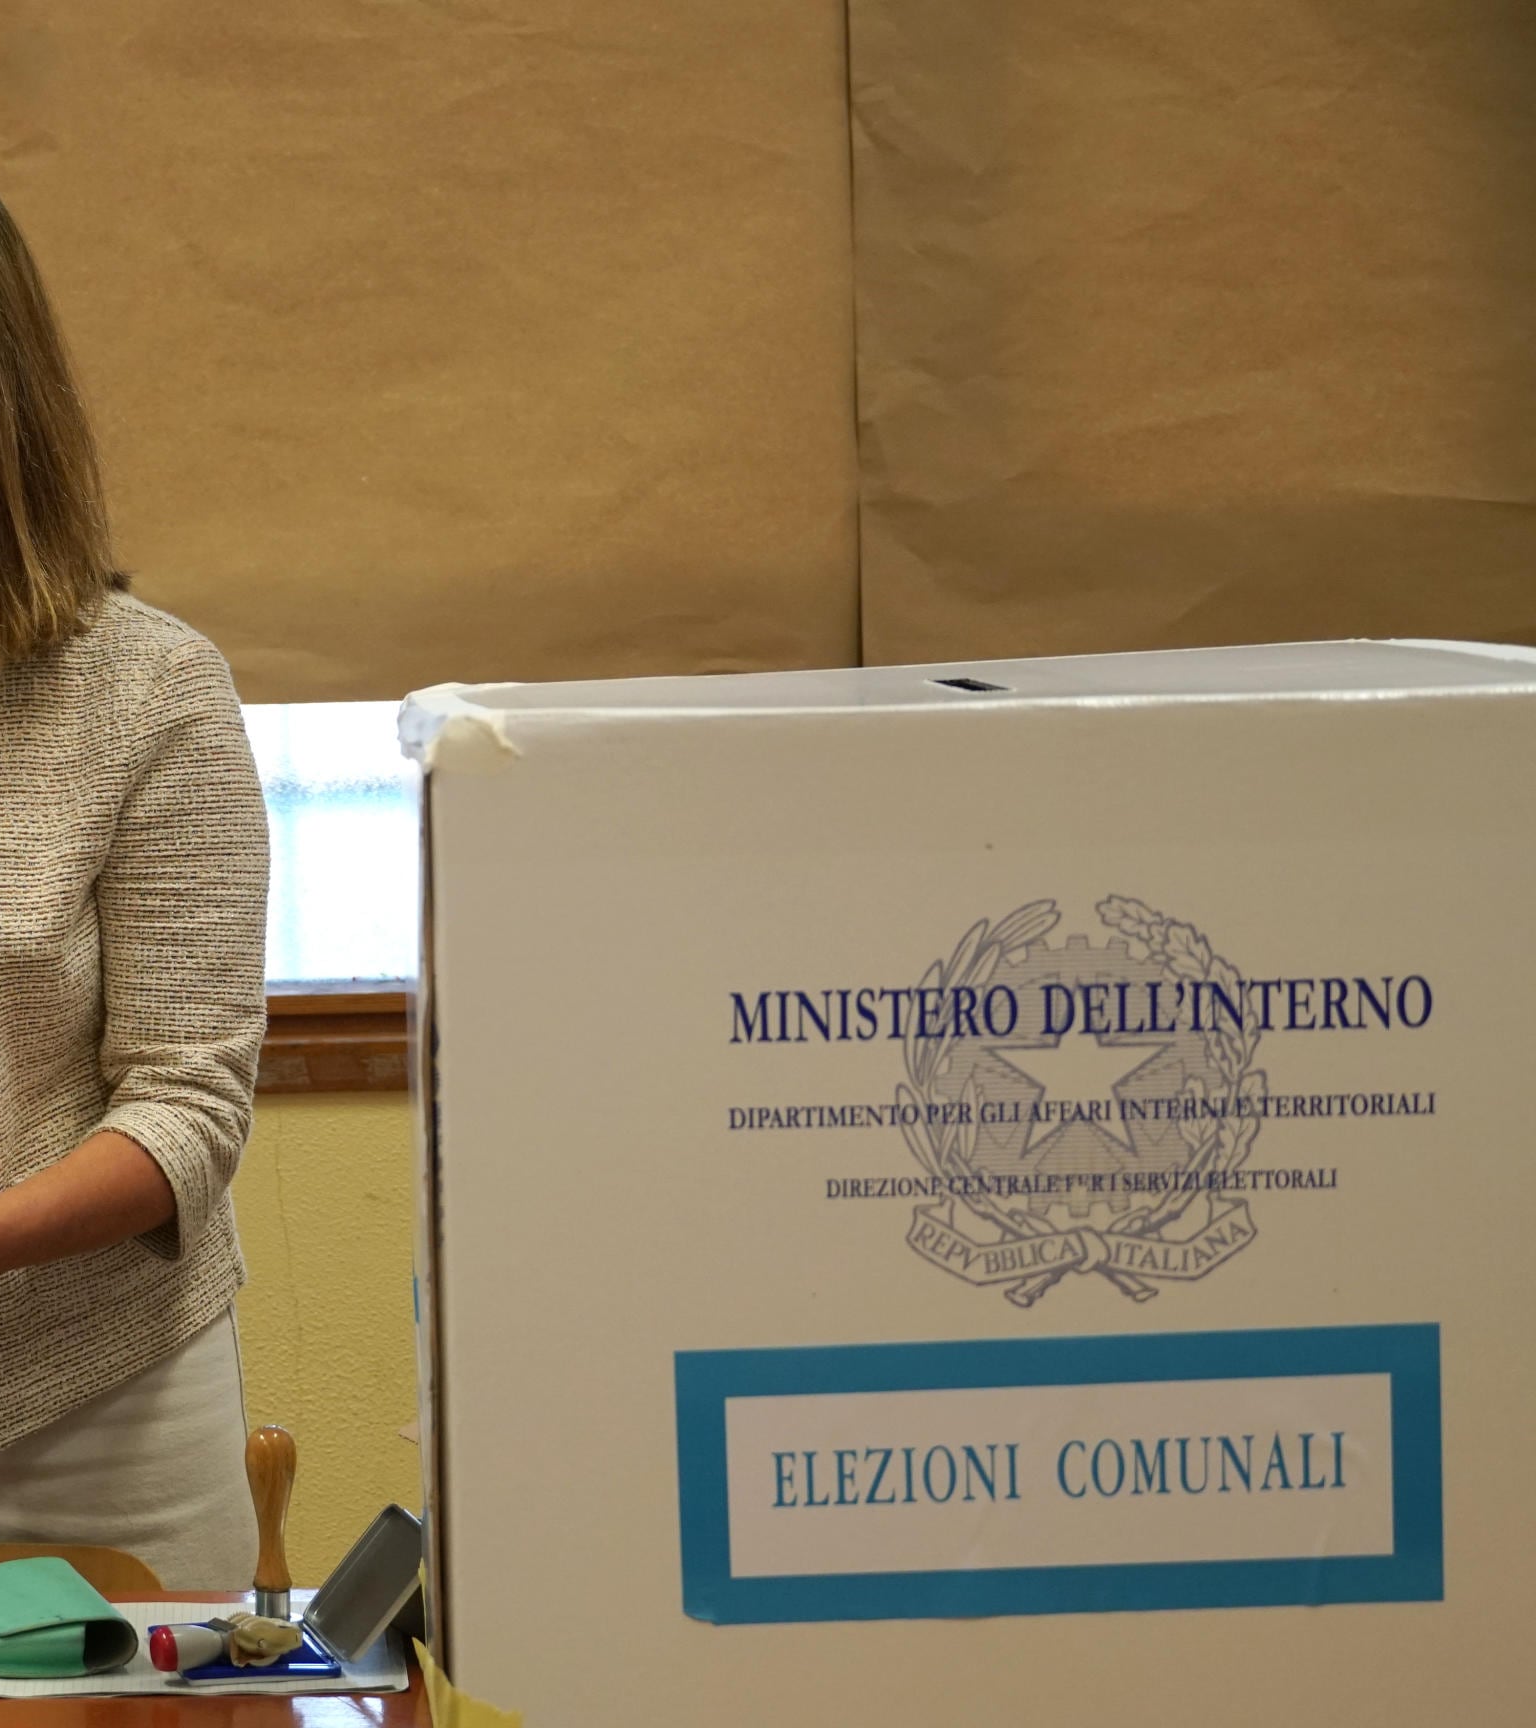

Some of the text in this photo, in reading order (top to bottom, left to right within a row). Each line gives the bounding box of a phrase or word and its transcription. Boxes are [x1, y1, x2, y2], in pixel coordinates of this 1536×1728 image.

[729, 975, 1433, 1044] MINISTERO DELL'INTERNO
[728, 1092, 1436, 1131] DIPARTIMENTO PER GLI AFFARI INTERNI E TERRITORIALI
[826, 1176, 943, 1199] DIREZIONE
[948, 1173, 1059, 1195] CENTRALE
[1122, 1170, 1201, 1192] SERVIZI
[1208, 1168, 1338, 1191] ELETTORALI
[1114, 1221, 1250, 1273] ITALIANA
[771, 1431, 1348, 1508] ELEZIONI COMUNALI
